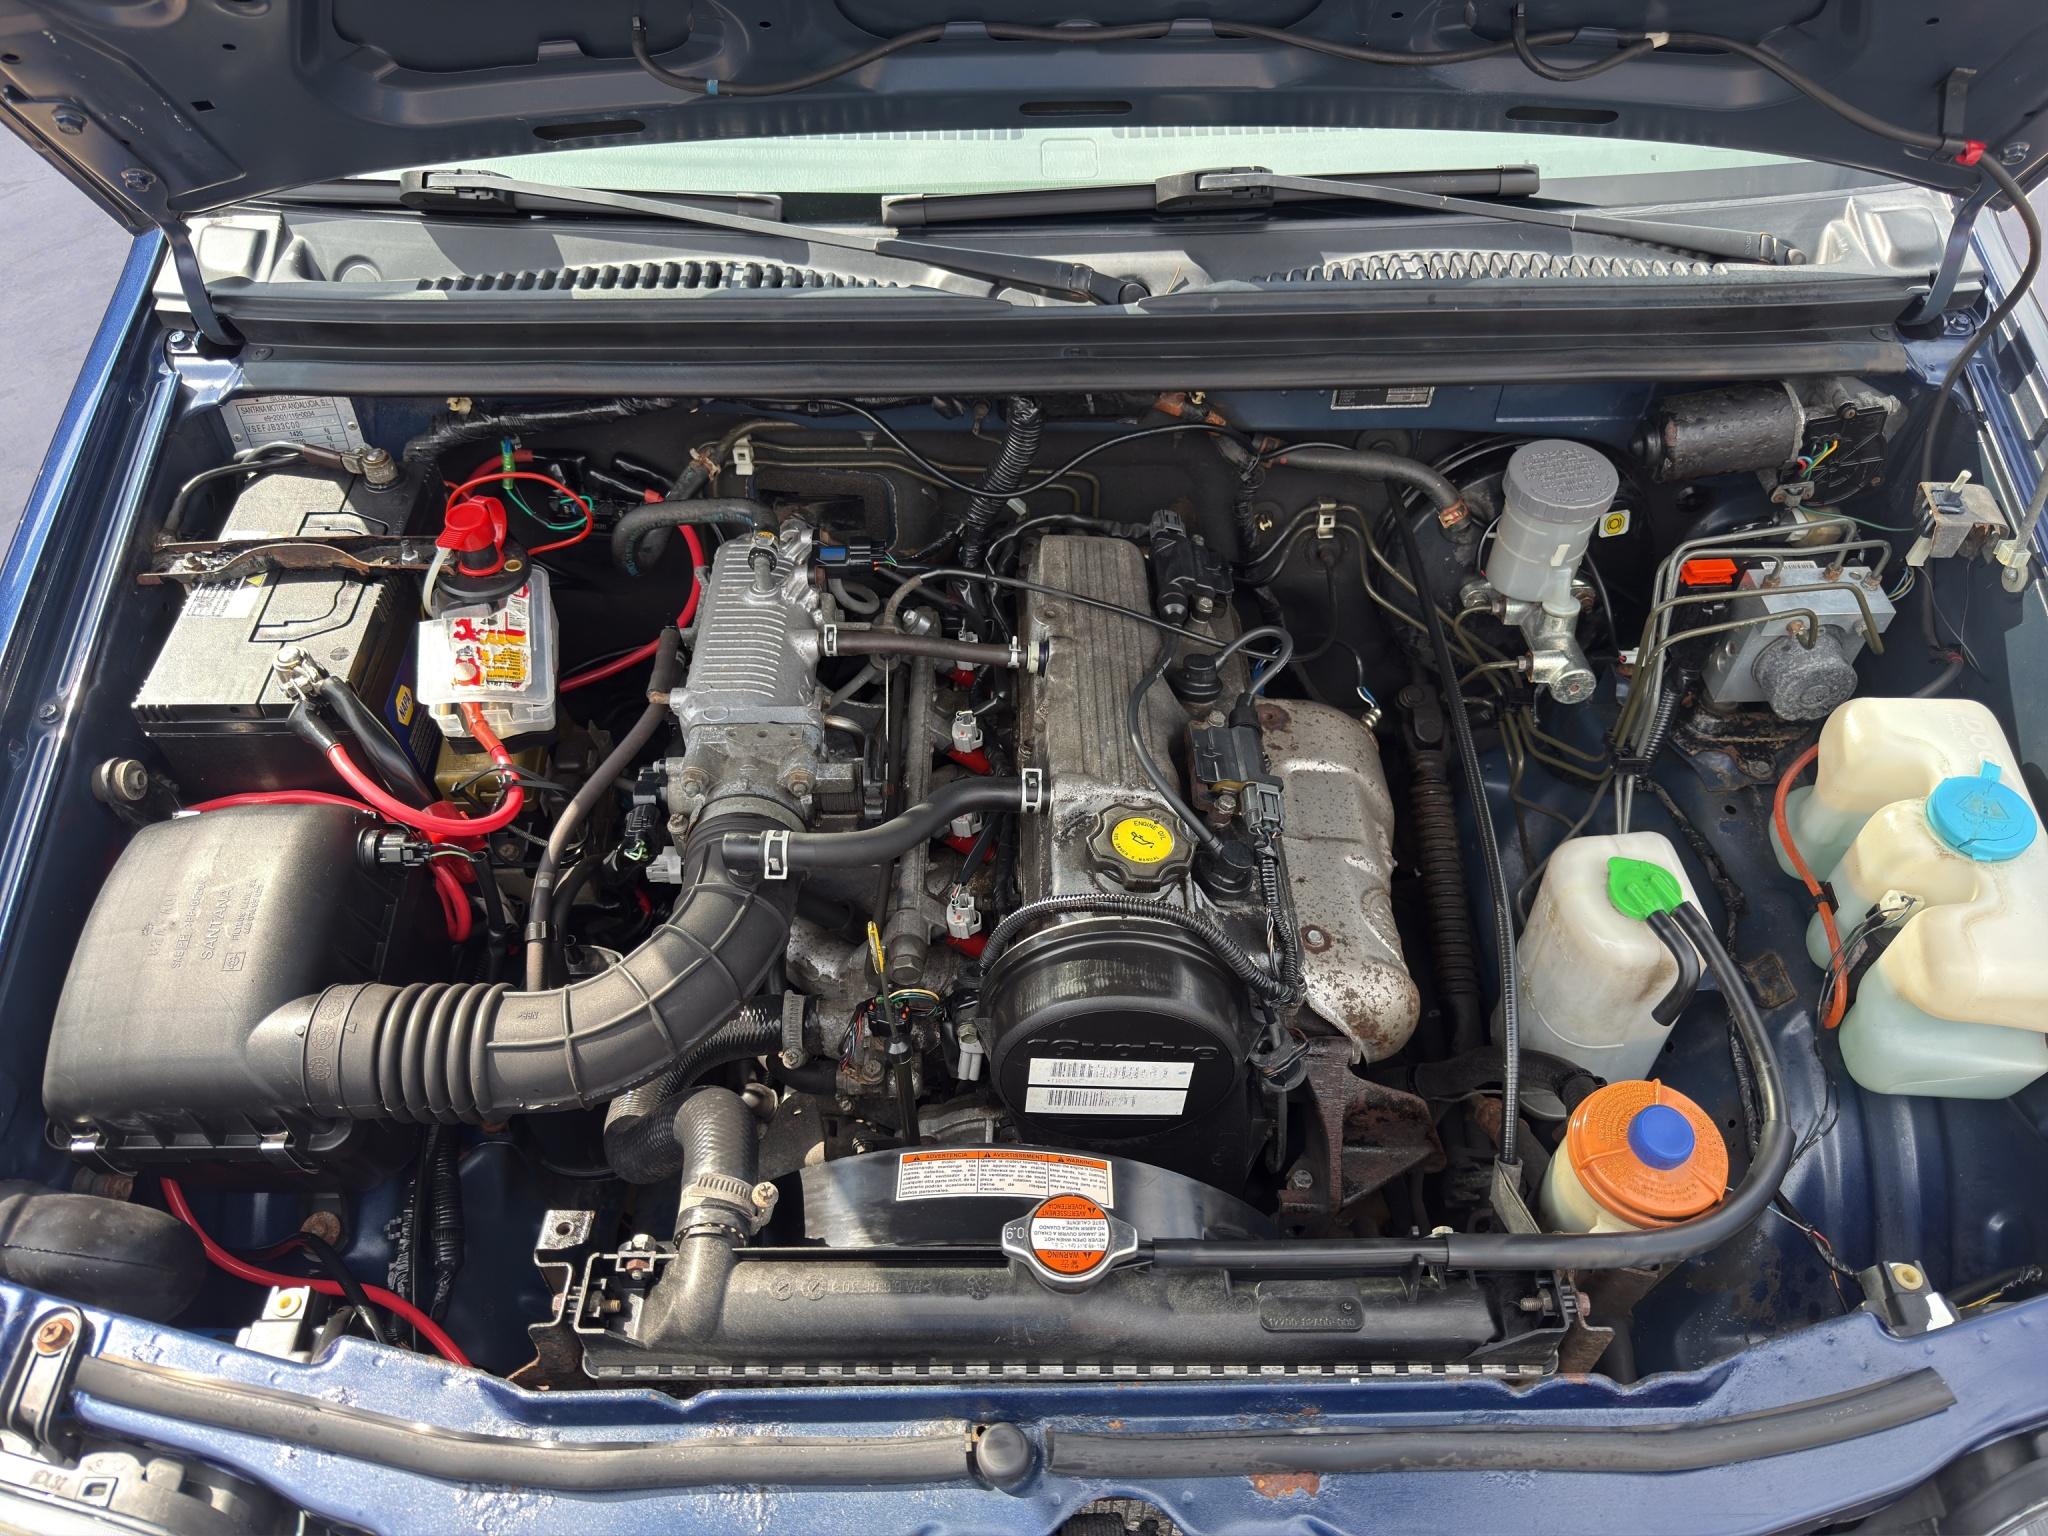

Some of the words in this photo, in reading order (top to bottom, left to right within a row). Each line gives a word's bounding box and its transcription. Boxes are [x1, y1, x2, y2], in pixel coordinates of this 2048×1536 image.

[240, 404, 266, 414] SANTANA
[266, 403, 288, 412] MOTOR
[1133, 820, 1158, 831] ENGINE
[1157, 830, 1167, 841] OIL
[200, 886, 235, 961] SANTANA
[1006, 1226, 1025, 1240] 0.9
